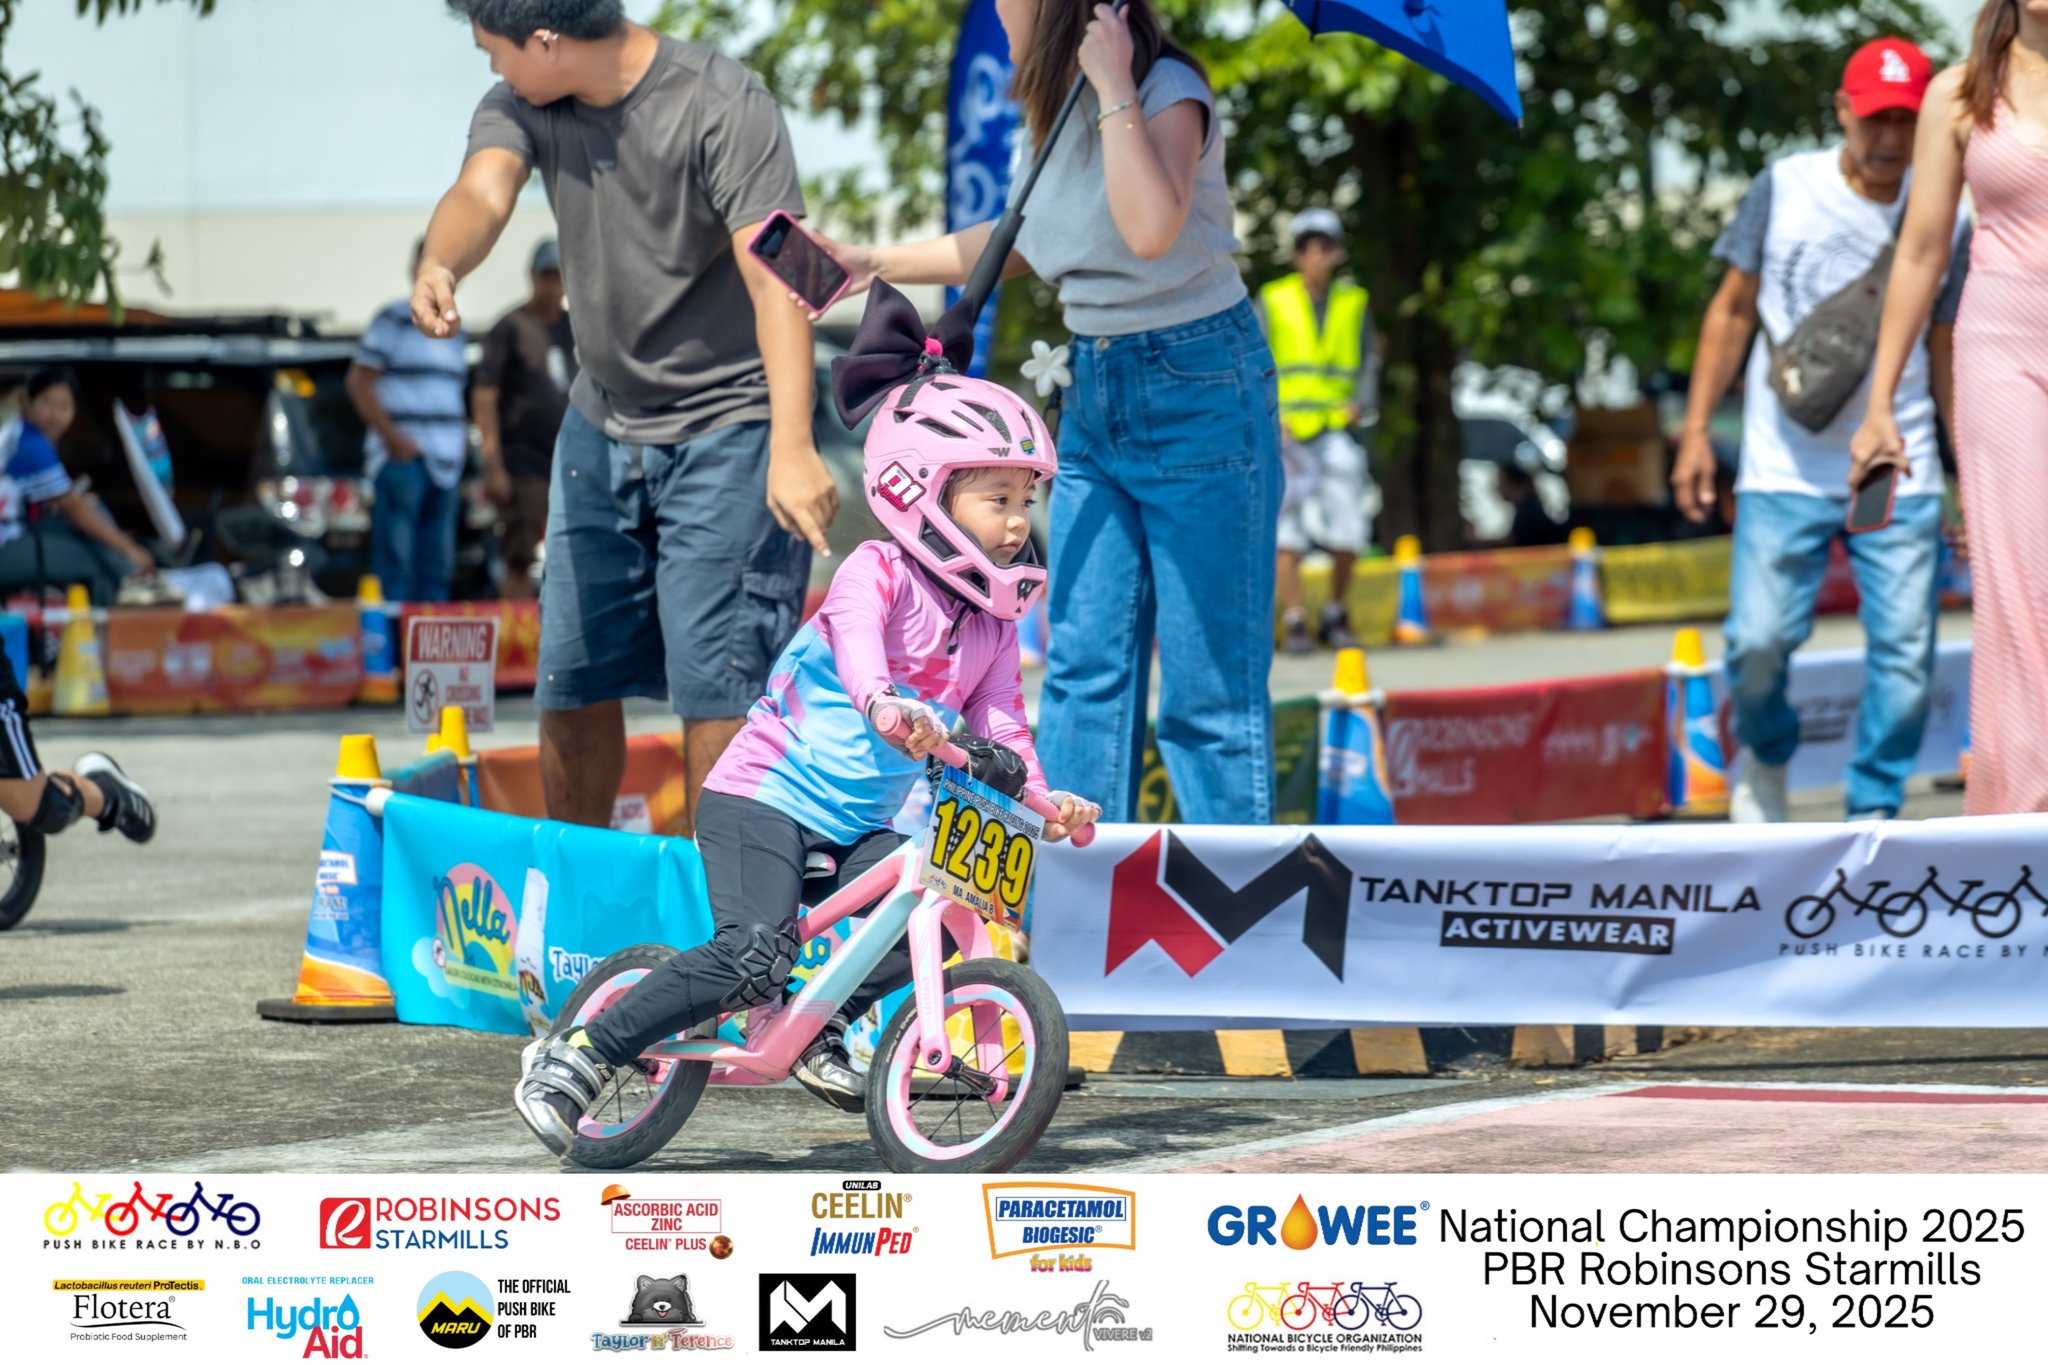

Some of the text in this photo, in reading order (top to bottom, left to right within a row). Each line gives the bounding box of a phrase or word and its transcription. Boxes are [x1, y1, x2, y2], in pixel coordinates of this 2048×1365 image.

[419, 624, 487, 660] WARNING
[930, 797, 1034, 907] 1239
[953, 884, 964, 901] MA.
[965, 891, 988, 911] AMALIA
[1360, 876, 1762, 913] TANKTOP MANILA
[1445, 917, 1670, 947] ACTIVEWEAR
[1778, 943, 1837, 956] PUSH
[1854, 944, 1908, 958] BIKE
[1922, 944, 1986, 958] RACE
[2002, 945, 2028, 957] BY
